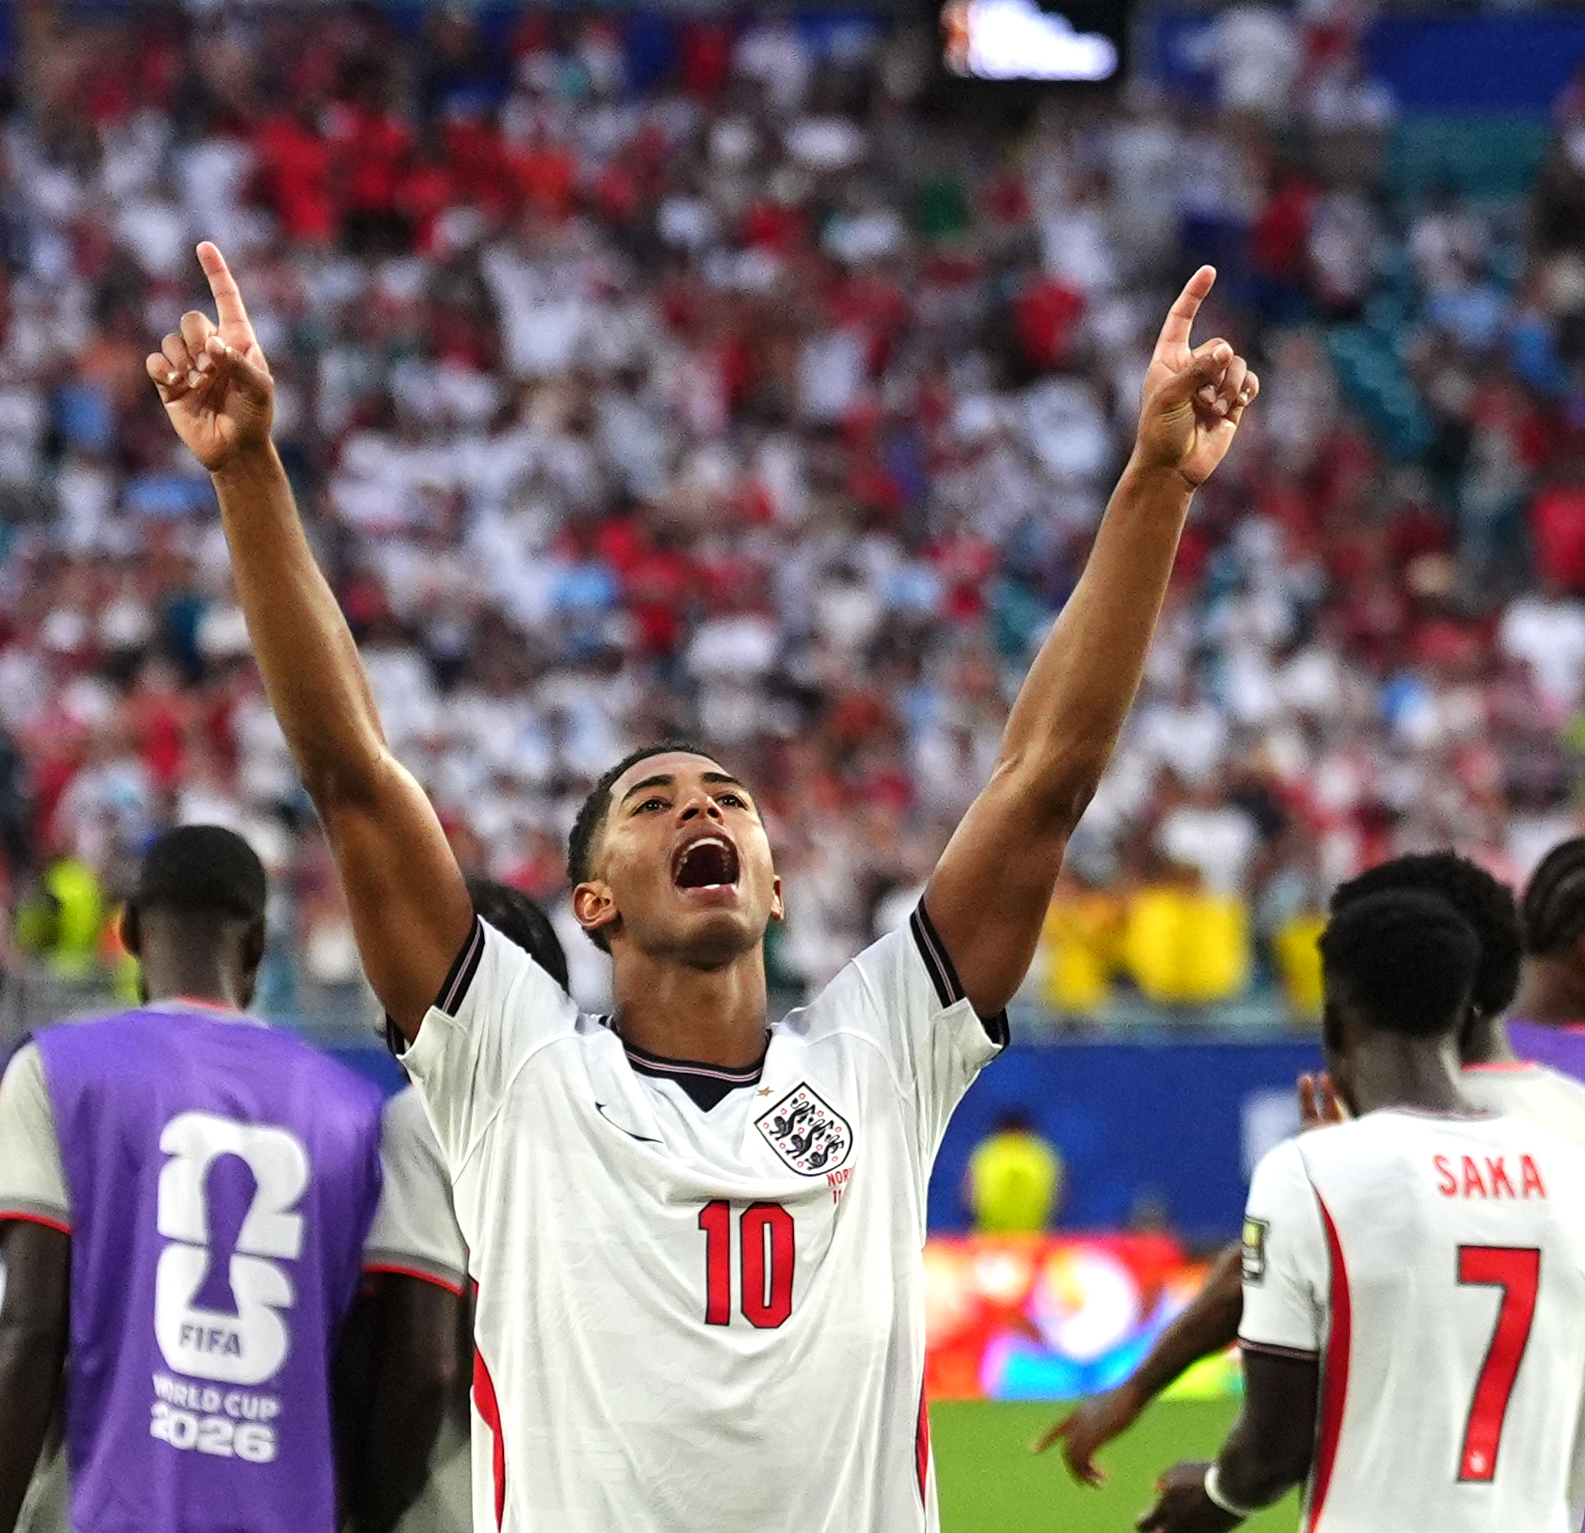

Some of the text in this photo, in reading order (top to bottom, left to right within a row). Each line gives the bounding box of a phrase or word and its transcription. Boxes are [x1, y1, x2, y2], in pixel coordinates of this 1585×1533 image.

[826, 1168, 851, 1187] NOR
[1434, 1154, 1547, 1200] SAKA
[698, 1200, 796, 1329] 10
[178, 1324, 242, 1358] FIFA
[1456, 1243, 1542, 1484] 7
[223, 1391, 281, 1420] CUP
[150, 1400, 277, 1463] 2026
